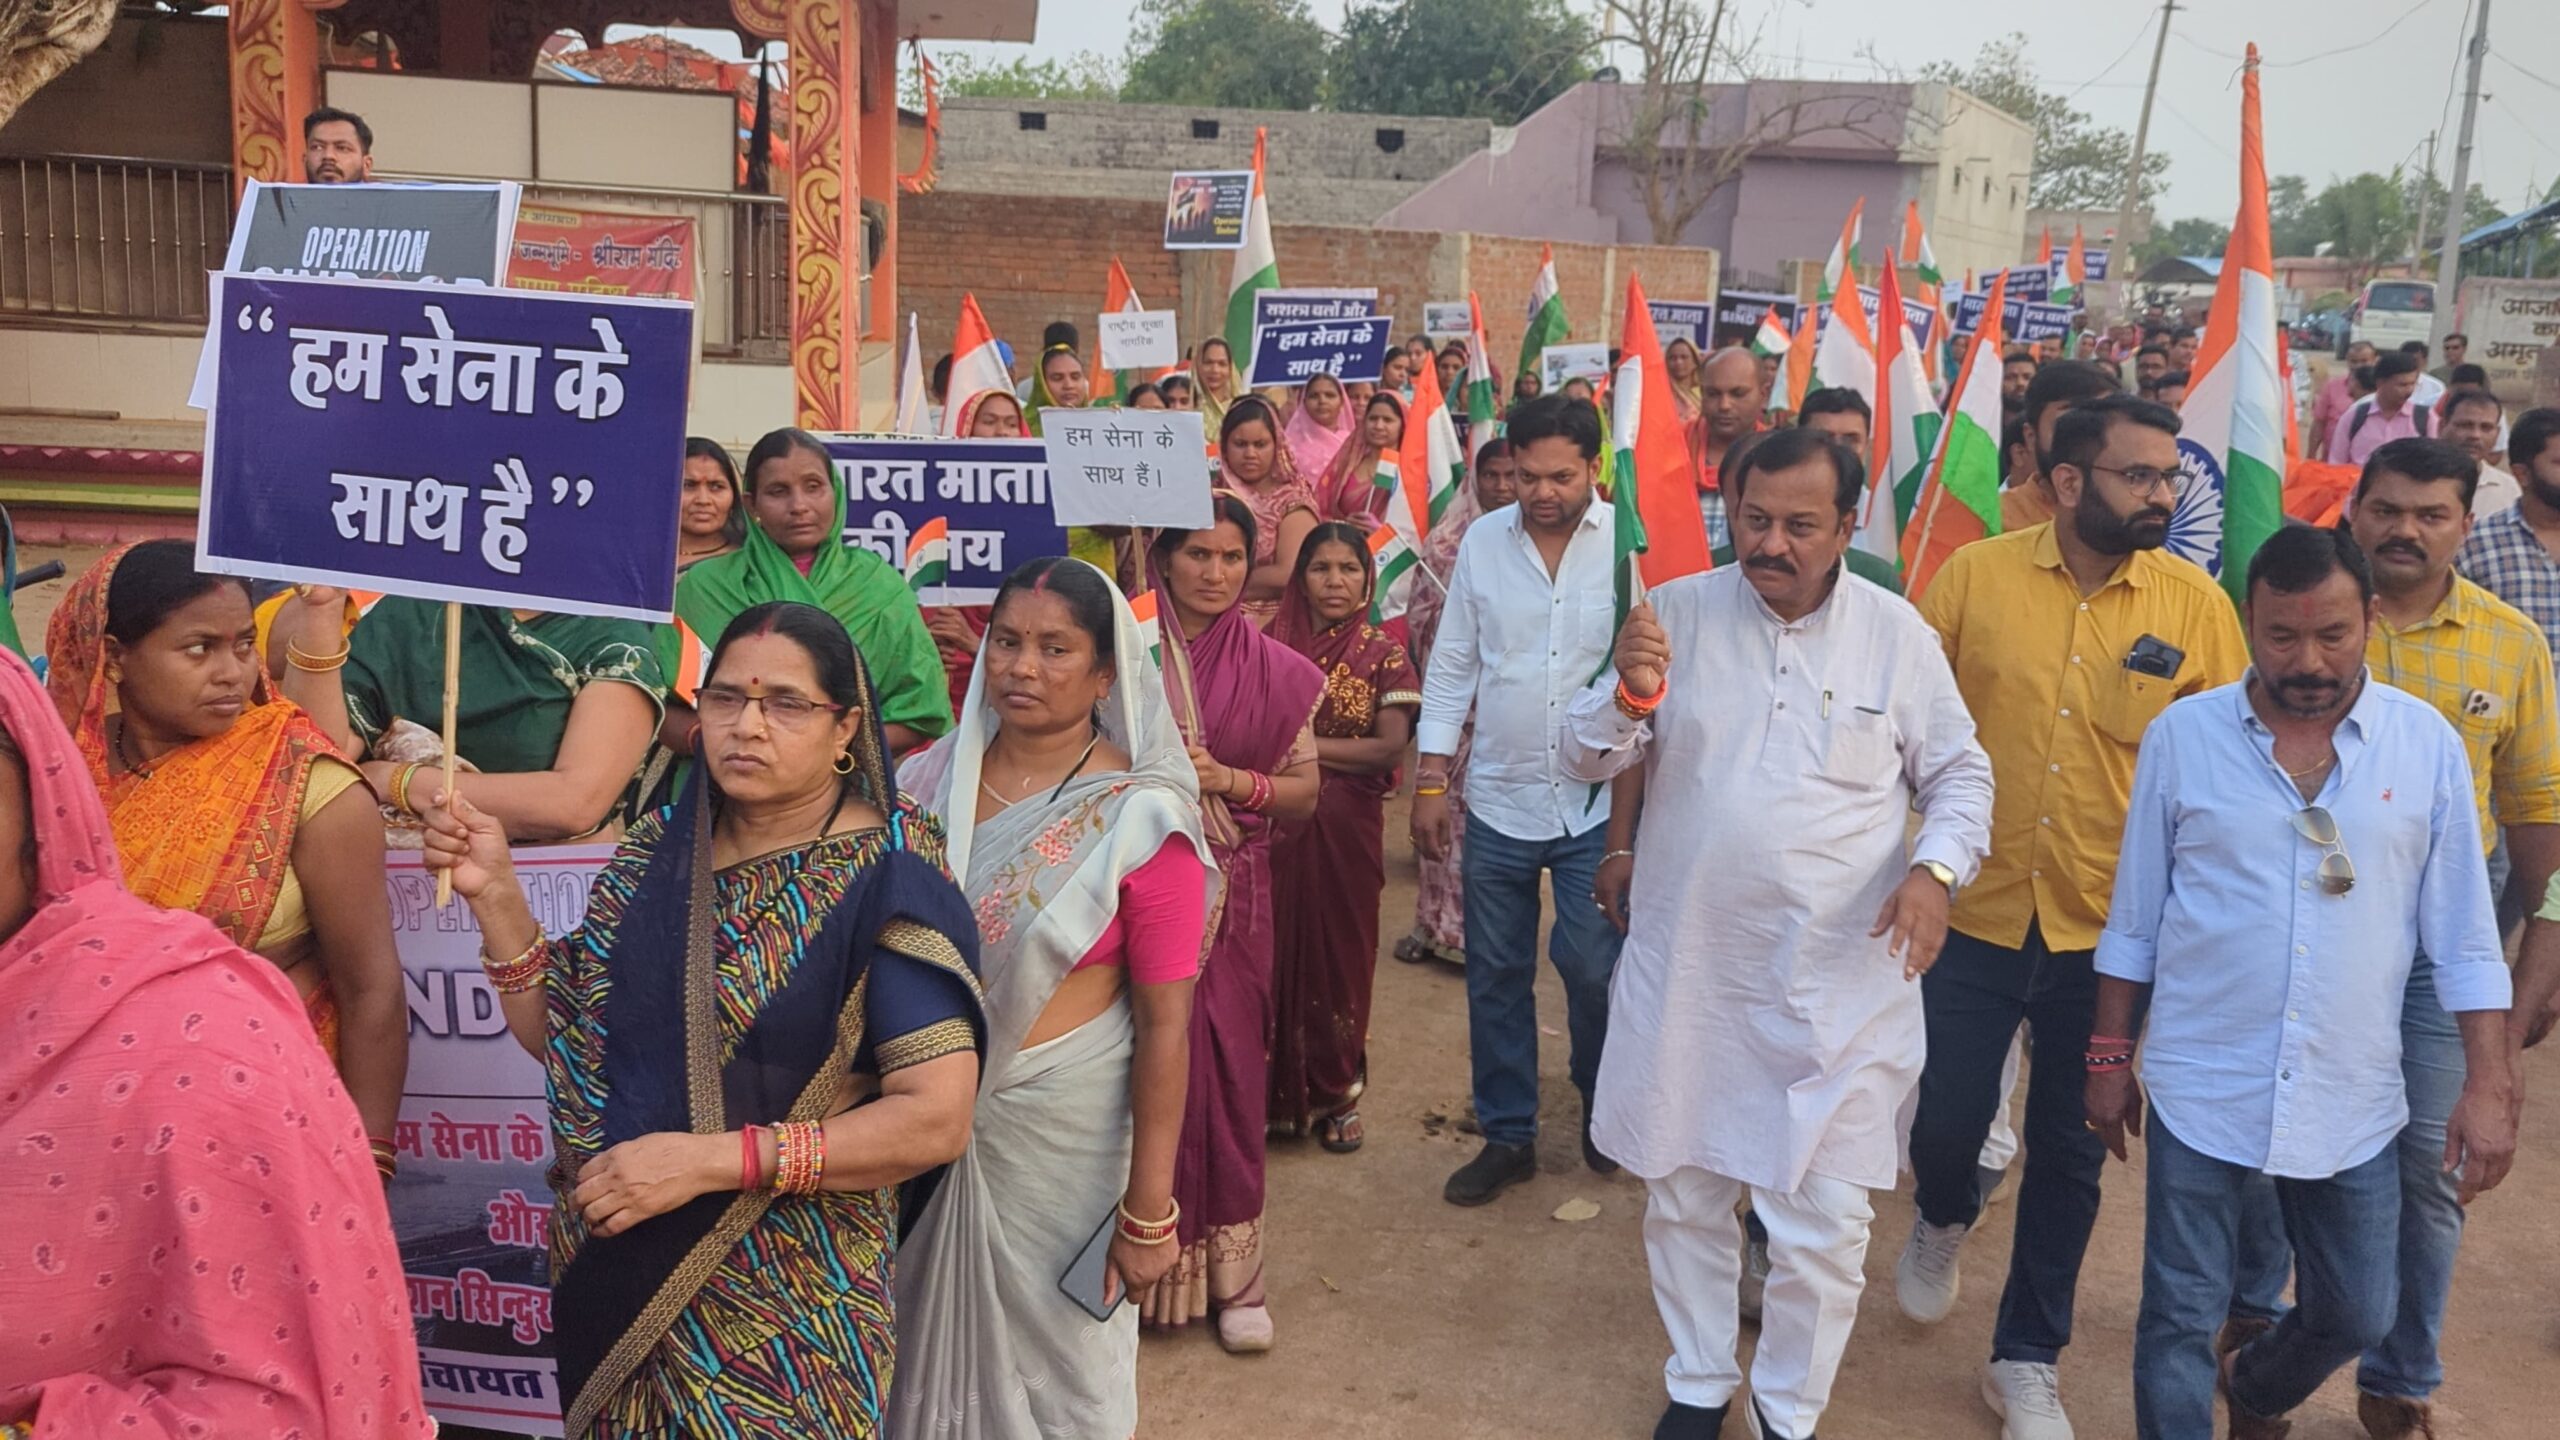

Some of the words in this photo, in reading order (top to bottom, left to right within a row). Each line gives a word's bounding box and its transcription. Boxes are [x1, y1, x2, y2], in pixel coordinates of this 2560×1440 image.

[301, 226, 430, 273] OPERATION
[1310, 325, 1350, 346] सेना
[1351, 322, 1374, 344] के
[400, 306, 542, 414] सेना
[554, 318, 630, 420] के
[1287, 359, 1327, 376] साथ
[1064, 427, 1093, 447] हम
[1103, 423, 1144, 448] सेना
[1154, 424, 1175, 449] के
[833, 459, 927, 502] ारत
[935, 460, 1048, 504] माता
[1083, 465, 1124, 485] साथ
[330, 472, 468, 553] साथ
[428, 1111, 502, 1161] सेना
[507, 1113, 544, 1162] के
